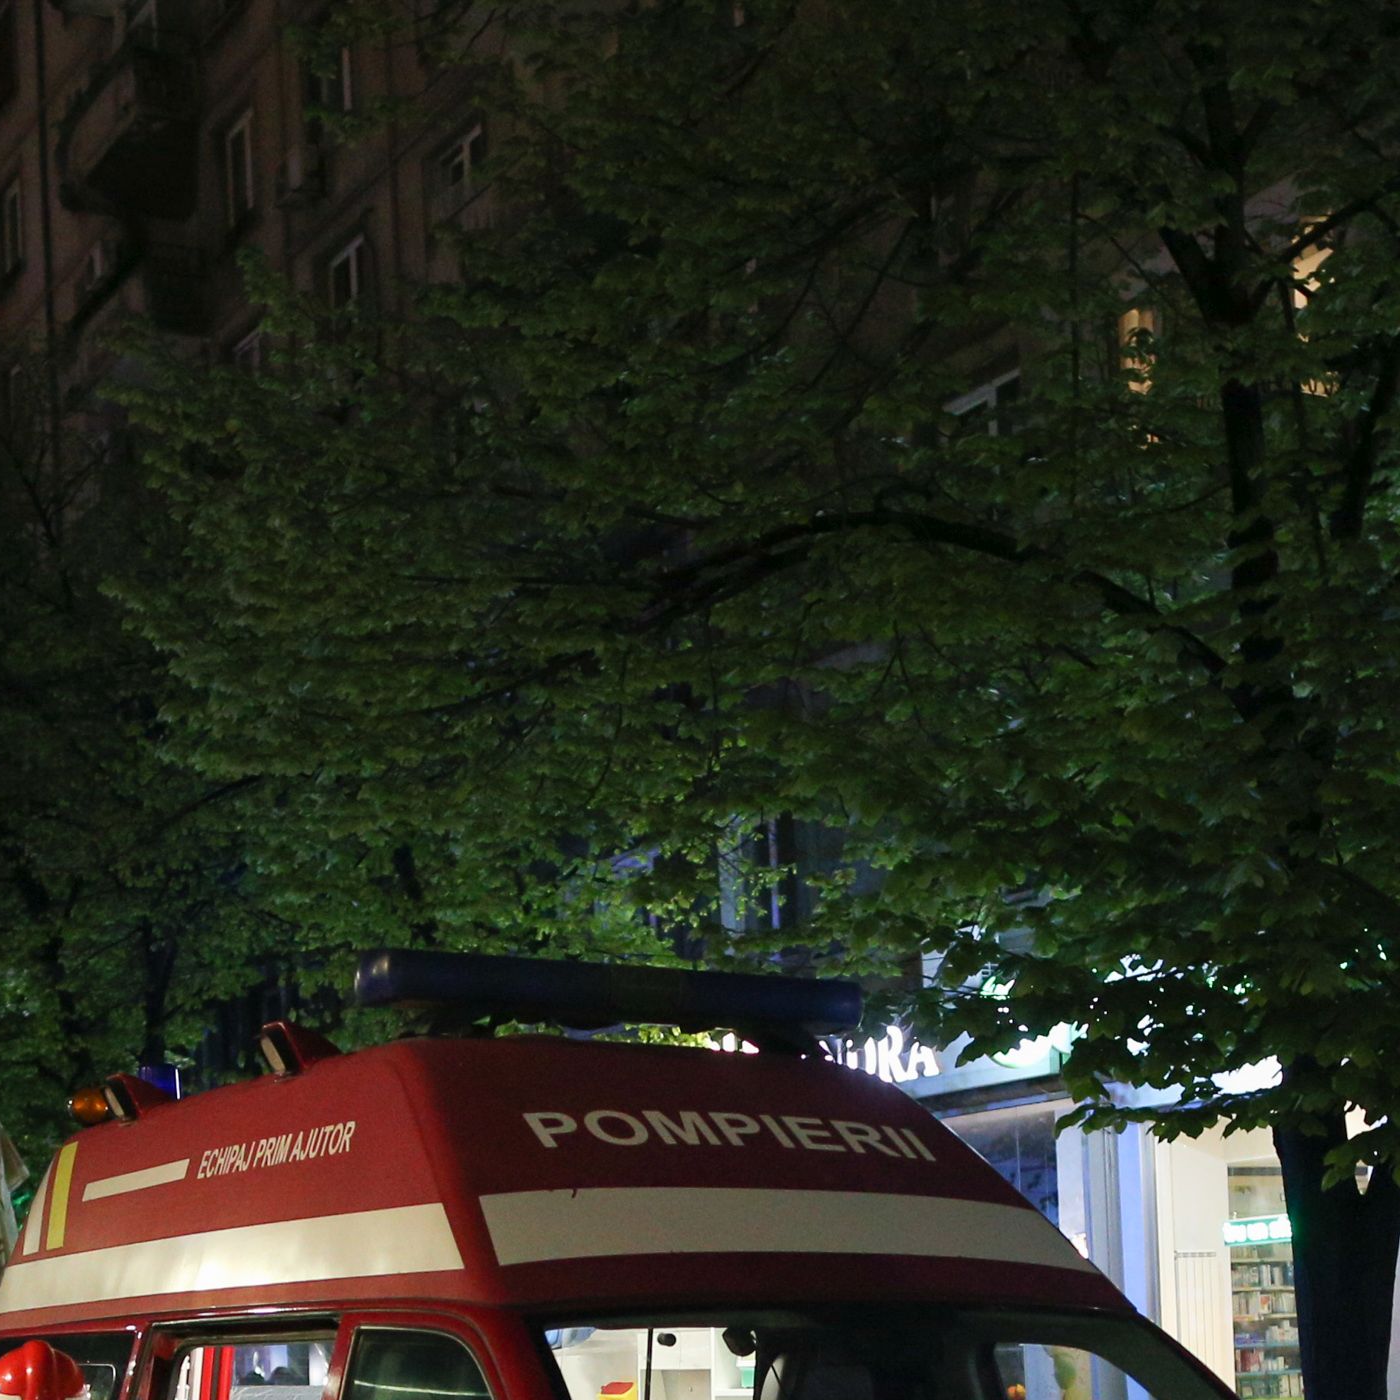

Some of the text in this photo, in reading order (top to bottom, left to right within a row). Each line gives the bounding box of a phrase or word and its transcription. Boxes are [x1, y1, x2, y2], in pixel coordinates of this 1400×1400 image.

[197, 1121, 356, 1179] ECHIPAJ PRIM AJUTOR
[522, 1109, 937, 1162] POMPIERII
